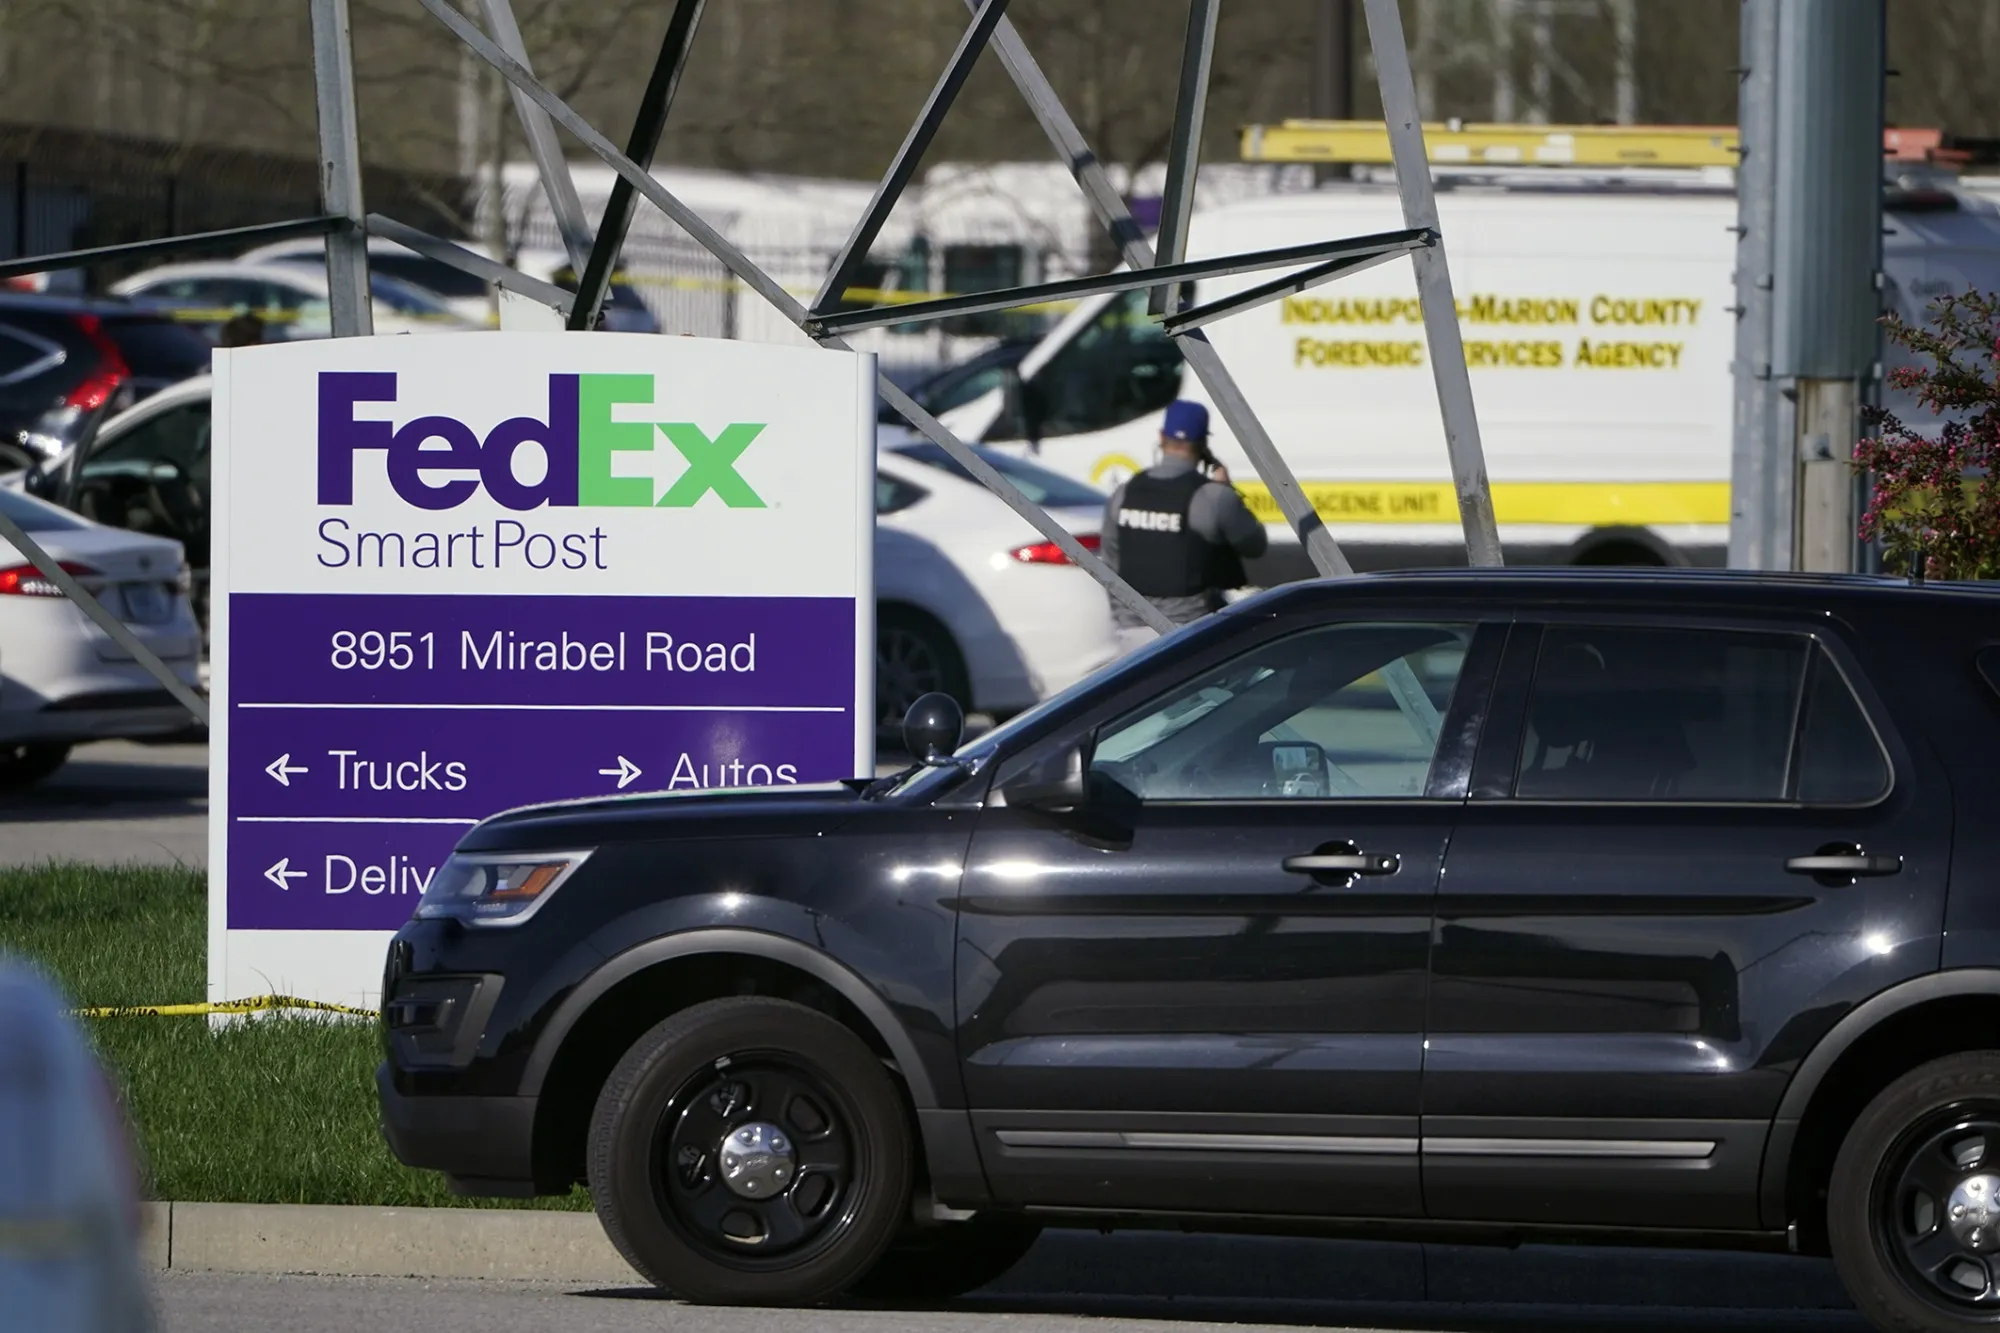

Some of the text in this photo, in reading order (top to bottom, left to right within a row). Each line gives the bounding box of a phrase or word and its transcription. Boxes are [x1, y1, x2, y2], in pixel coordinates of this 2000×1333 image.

[1283, 295, 1703, 325] INDIANAPO-MARION COUNTY
[1295, 336, 1685, 369] FORENSIC ERVICES AGENCY
[316, 371, 768, 513] FedEx
[1118, 507, 1182, 533] POLICE
[1312, 490, 1383, 514] SCENE
[1388, 490, 1440, 514] UNIT
[316, 517, 608, 570] SmartPost
[330, 630, 756, 672] 8951 Mirabel Road
[328, 750, 467, 791] Trucks
[668, 752, 798, 790] Autos
